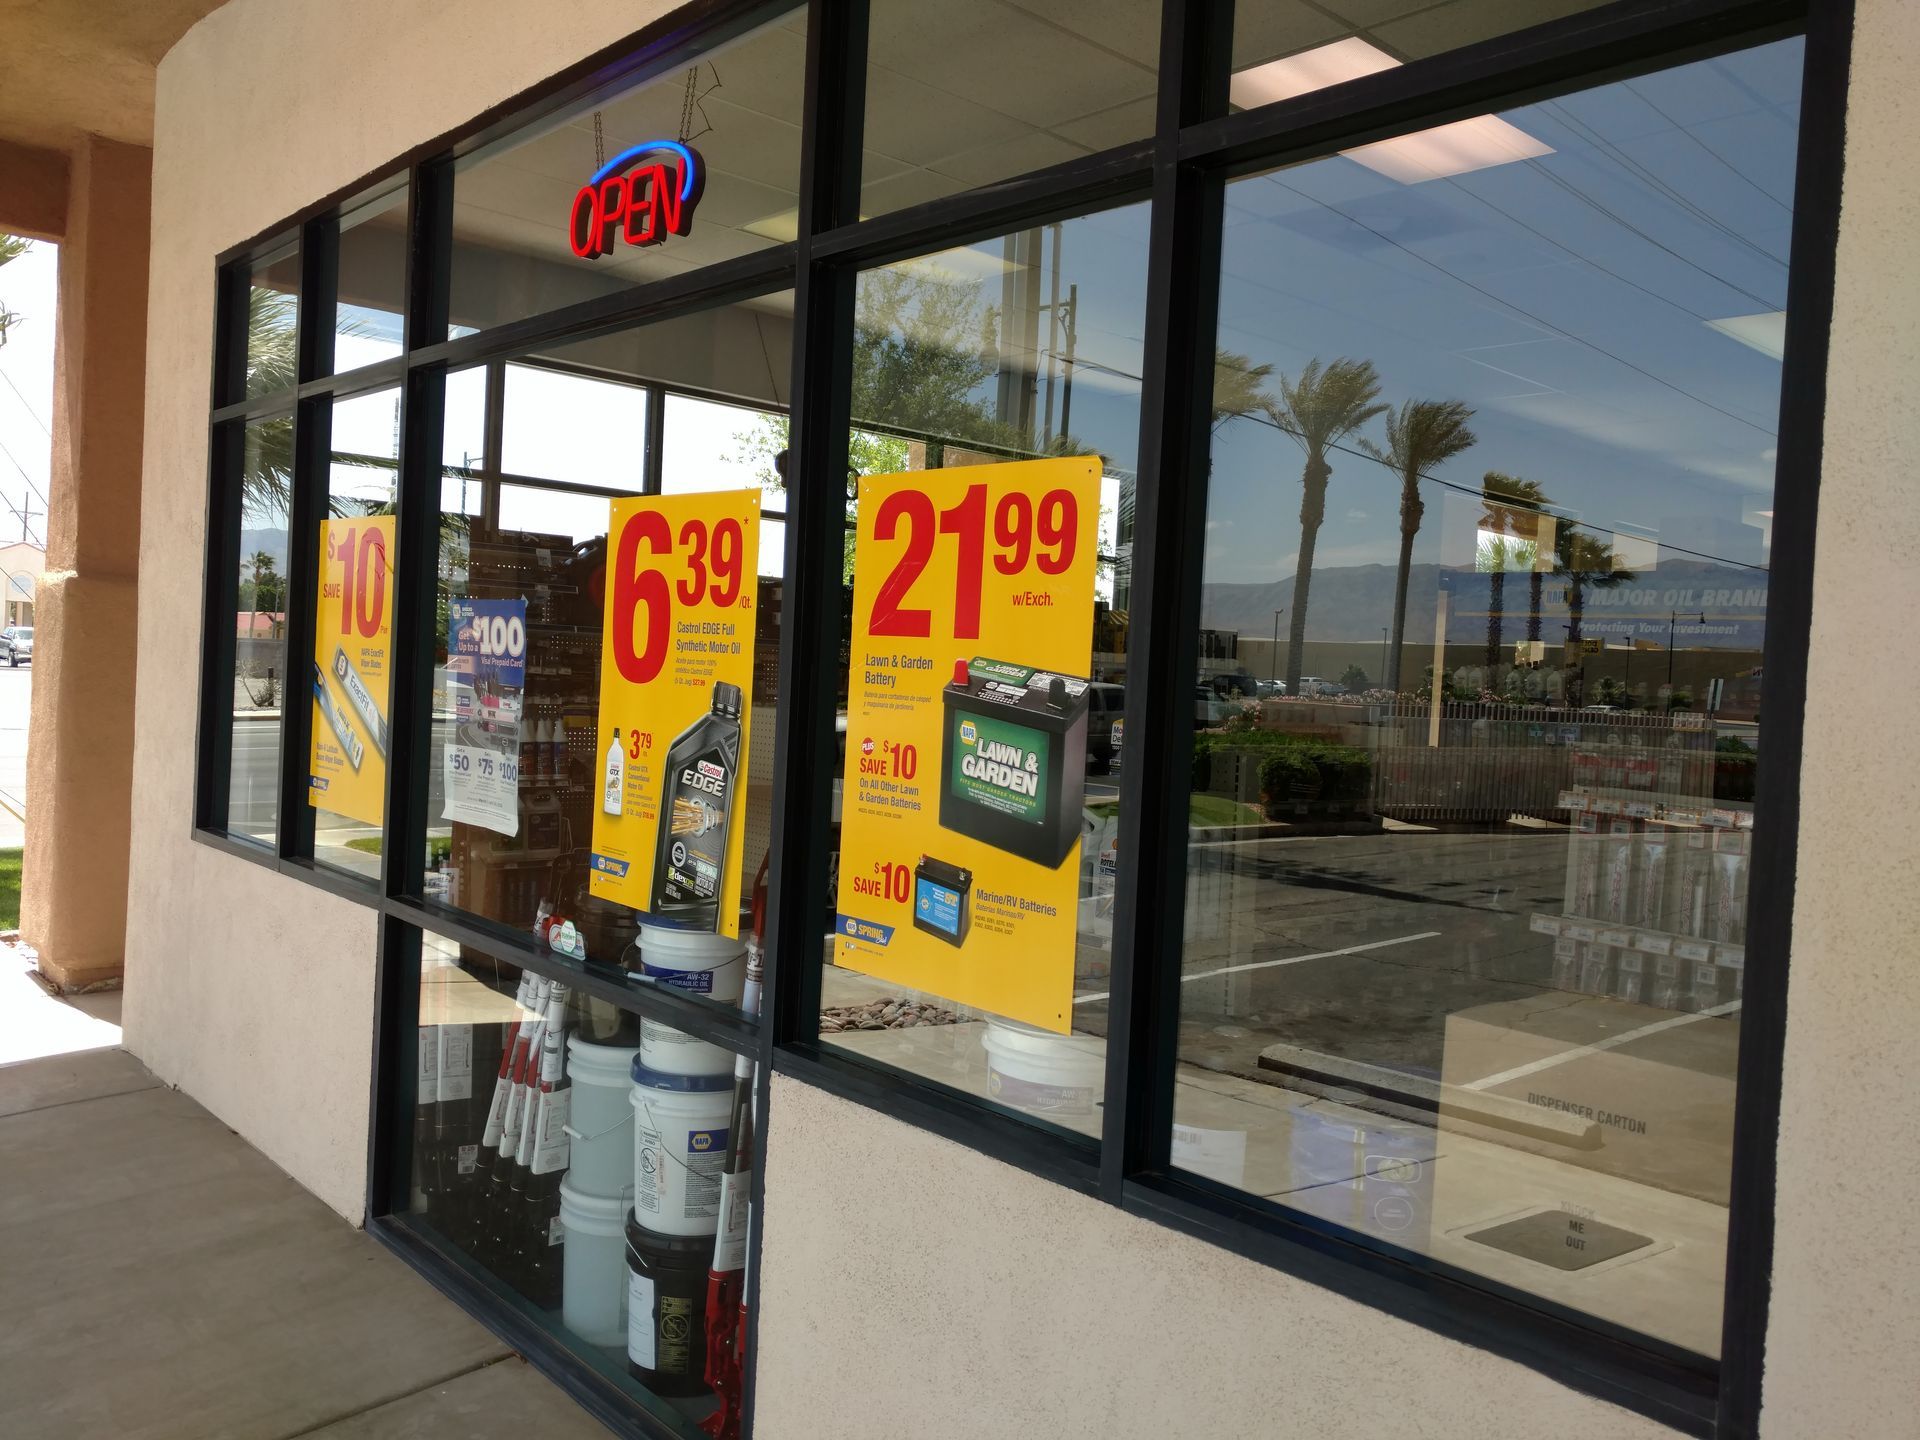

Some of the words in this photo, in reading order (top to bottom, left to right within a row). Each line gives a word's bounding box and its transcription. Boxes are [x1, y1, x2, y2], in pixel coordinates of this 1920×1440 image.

[570, 157, 685, 257] OPEN
[323, 583, 341, 599] SAVE
[1011, 590, 1055, 608] w/Exch.
[1589, 588, 1658, 607] MAJOR
[1663, 588, 1694, 607] OIL
[677, 621, 701, 634] Castrol
[702, 622, 721, 635] EDGE
[722, 623, 735, 636] Full
[1639, 622, 1666, 634] Your
[1668, 623, 1740, 636] Investment
[458, 641, 467, 653] Up
[467, 642, 474, 652] to
[676, 638, 708, 652] Synthetic
[709, 640, 729, 653] Motor
[731, 641, 741, 654] Oil
[865, 653, 889, 668] Lawn
[891, 654, 899, 668] &
[901, 654, 933, 670] Garden
[864, 670, 897, 689] Battery
[349, 674, 370, 713] ExactFit
[961, 726, 976, 739] NAPA
[861, 741, 875, 752] PLUS
[976, 736, 1023, 769] LAWN
[1024, 751, 1040, 774] &
[609, 768, 620, 776] GTX
[703, 763, 724, 779] Castrol
[860, 757, 887, 776] SAVE
[960, 752, 1040, 798] GARDEN
[681, 768, 727, 798] EDGE
[860, 777, 869, 788] On
[870, 778, 879, 790] All
[880, 779, 899, 793] Other
[900, 783, 919, 797] Lawn
[858, 791, 865, 802] &
[865, 791, 889, 806] Garden
[890, 795, 922, 812] Batteries
[853, 876, 881, 898] SAVE
[976, 888, 1018, 907] Marine/RV
[1019, 898, 1057, 917] Batteries
[858, 923, 884, 940] SPRING
[668, 979, 698, 988] HYDRAULIC
[687, 973, 710, 981] AW-32
[1527, 1092, 1594, 1121] DISPENSER
[1597, 1110, 1647, 1135] CARTON
[694, 1137, 709, 1146] NAPA
[1568, 1219, 1585, 1234] ME
[1566, 1235, 1587, 1251] OUT
